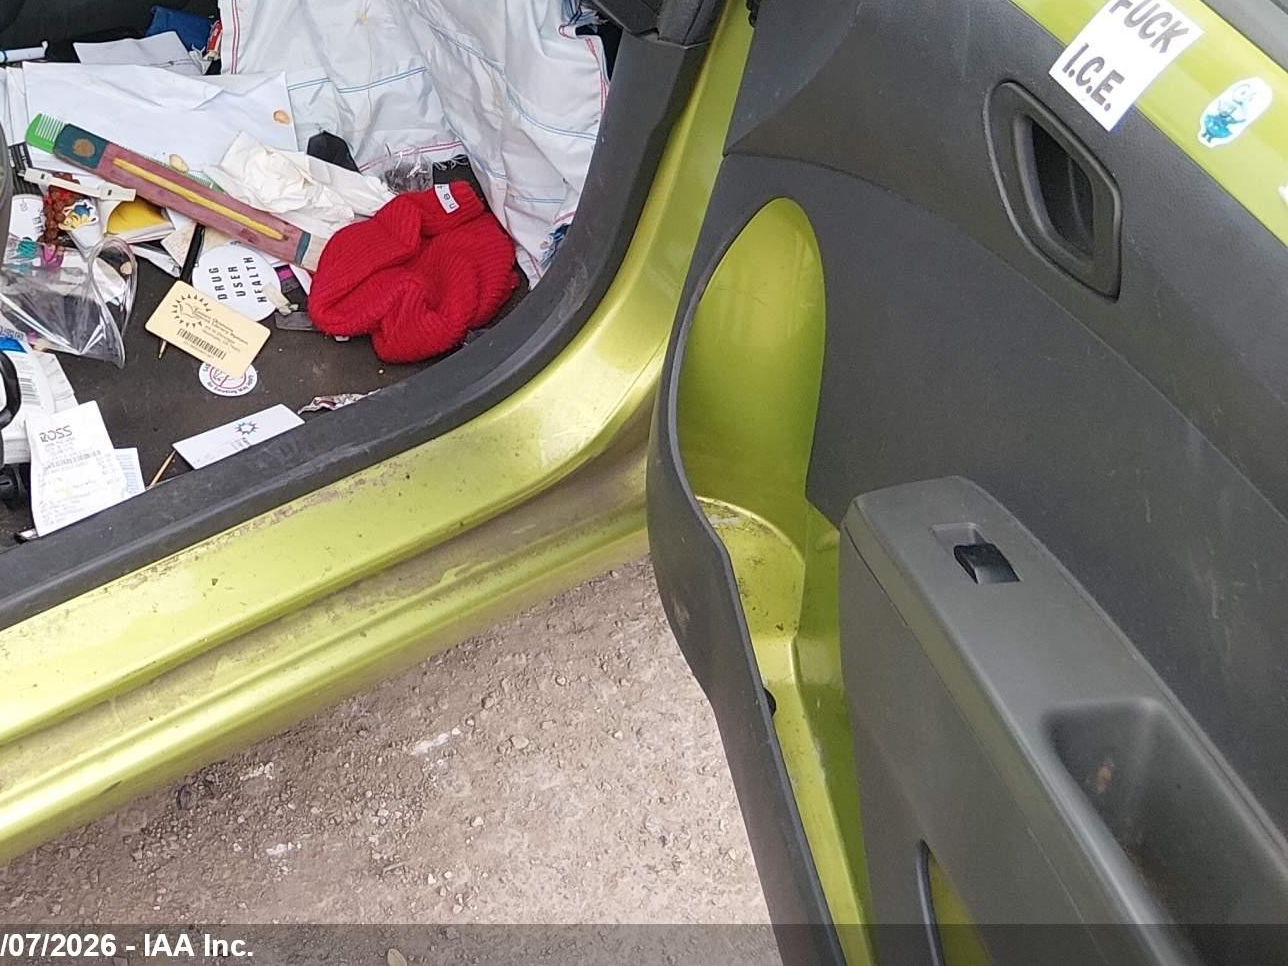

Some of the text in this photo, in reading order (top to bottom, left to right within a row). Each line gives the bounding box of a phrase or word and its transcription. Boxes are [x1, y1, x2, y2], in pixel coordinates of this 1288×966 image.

[1062, 42, 1125, 111] I.C.E.
[208, 267, 229, 301] DRUG
[227, 266, 247, 297] USER
[243, 257, 268, 303] HEALTH
[39, 425, 73, 443] ROSS
